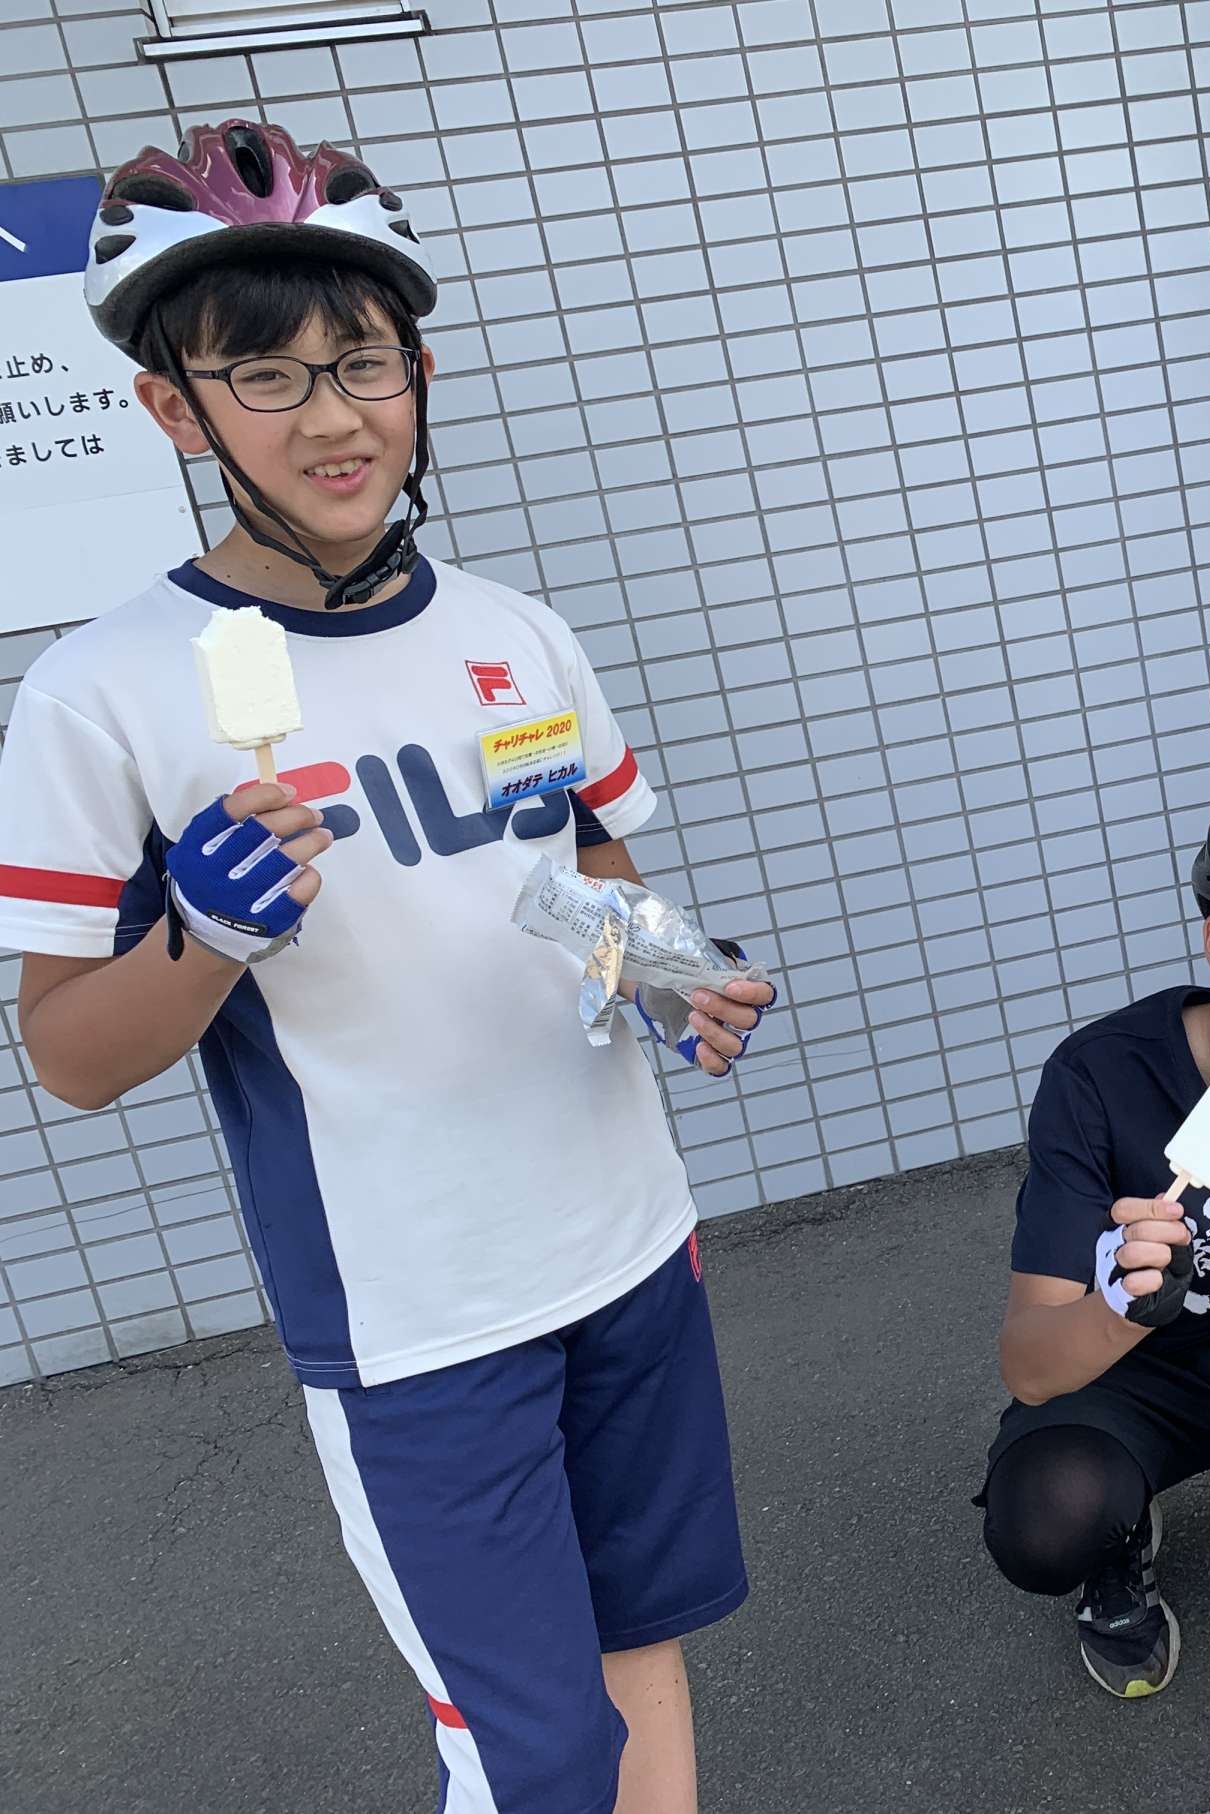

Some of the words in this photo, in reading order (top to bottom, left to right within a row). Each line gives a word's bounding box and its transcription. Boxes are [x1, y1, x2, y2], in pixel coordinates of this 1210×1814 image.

[0, 352, 69, 379] 止め、
[0, 433, 105, 468] ましては
[493, 728, 544, 753] チャリチャレ
[546, 719, 572, 738] 2020
[501, 772, 544, 797] オオダテ
[548, 762, 578, 783] ヒカル
